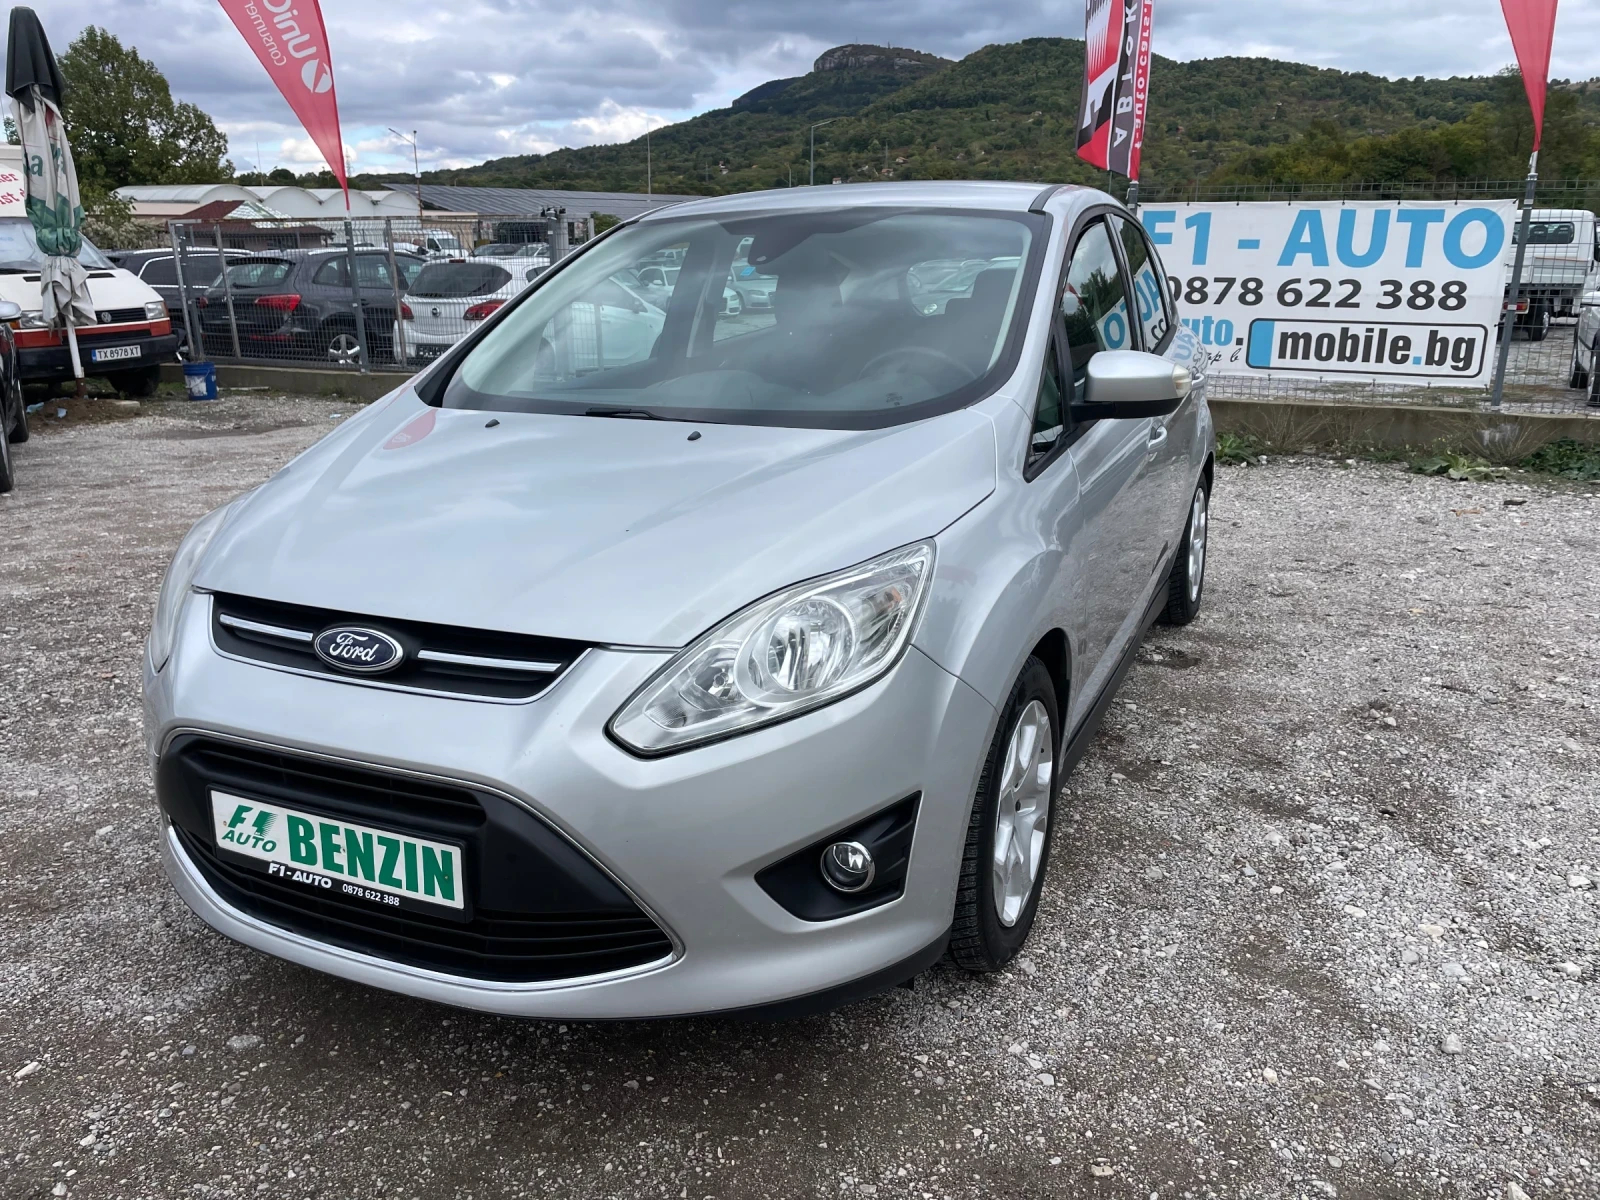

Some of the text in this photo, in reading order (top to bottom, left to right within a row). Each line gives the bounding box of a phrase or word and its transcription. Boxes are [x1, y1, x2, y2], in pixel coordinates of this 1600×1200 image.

[1277, 207, 1506, 270] AUTO
[1277, 278, 1362, 308] 622
[1376, 280, 1468, 311] 388
[97, 346, 140, 360] TX 8978 XT
[1278, 327, 1477, 372] mobile.bg
[329, 632, 380, 661] Ford
[221, 828, 277, 853] AUTO
[286, 814, 456, 902] BENZIN
[268, 862, 400, 907] F1-AUTO 0878 622 388
